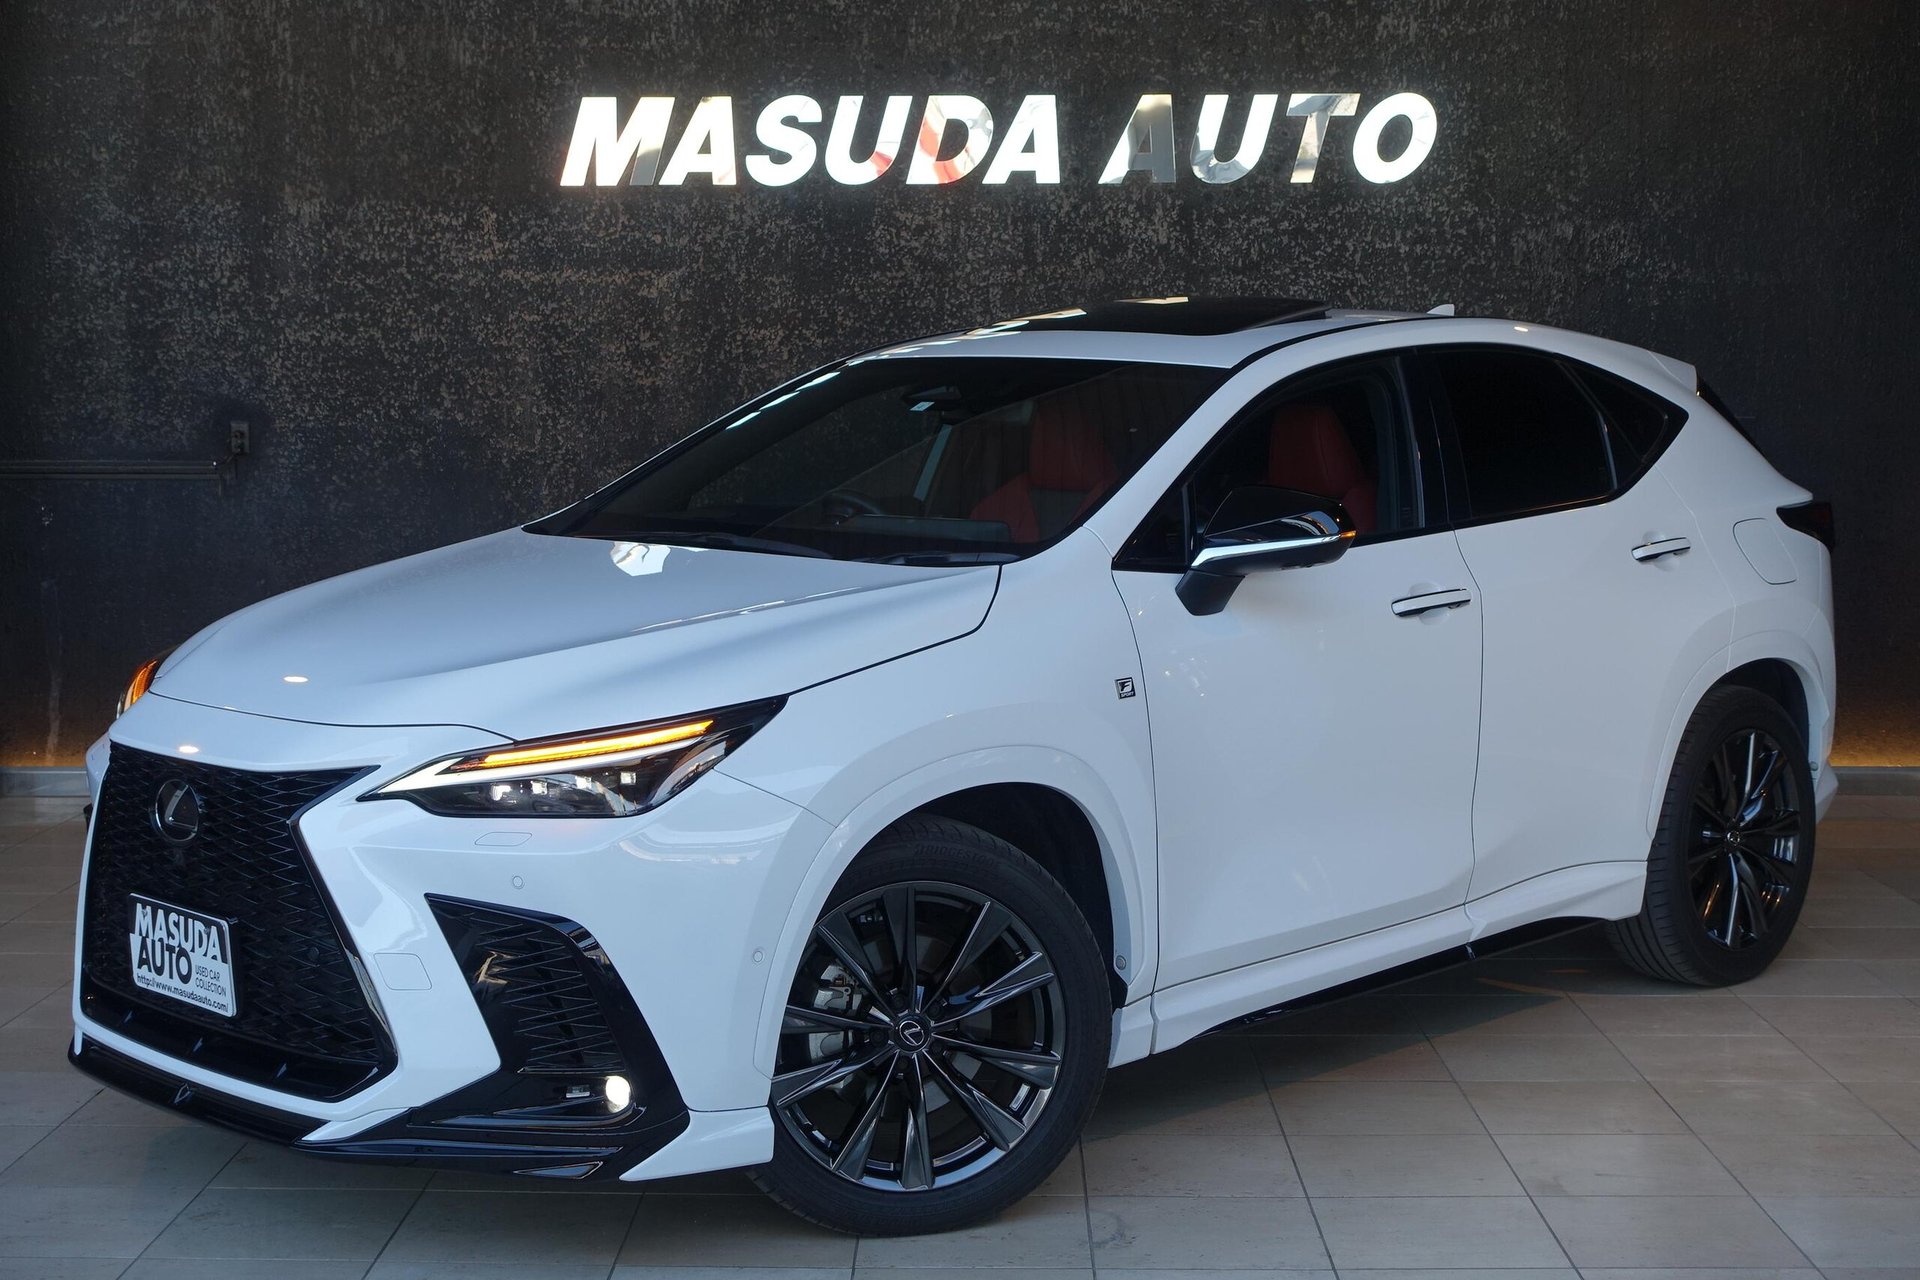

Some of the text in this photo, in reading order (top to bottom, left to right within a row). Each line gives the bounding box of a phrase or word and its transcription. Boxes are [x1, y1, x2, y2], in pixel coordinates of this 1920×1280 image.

[560, 92, 1438, 186] MASUDA AUTO
[135, 903, 224, 962] MASUDA
[137, 936, 192, 984] AUTO
[195, 965, 220, 982] USED CAR
[195, 977, 227, 997] COLLECTION
